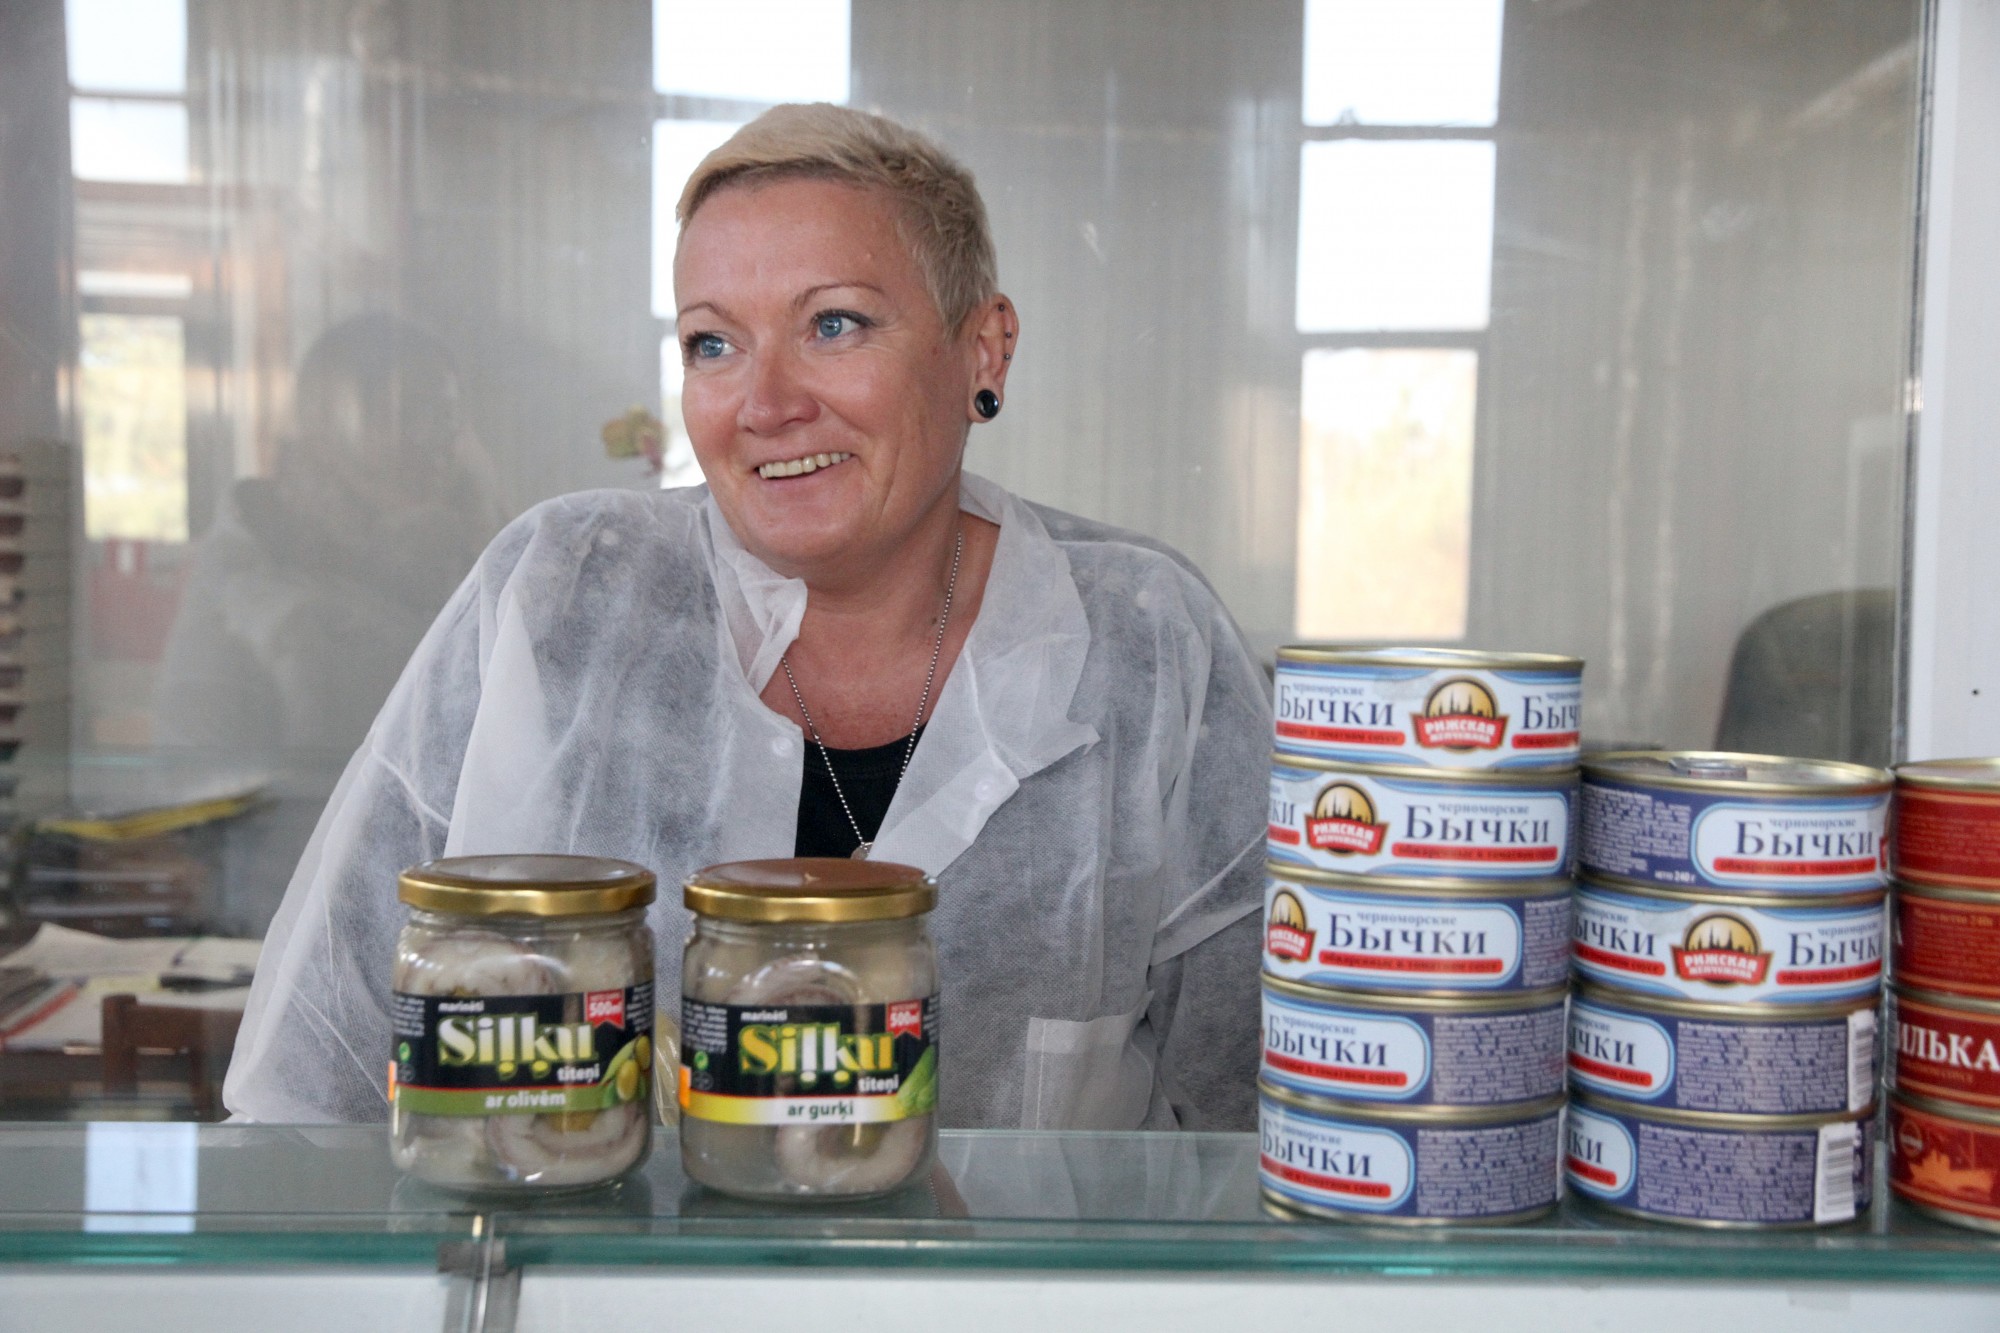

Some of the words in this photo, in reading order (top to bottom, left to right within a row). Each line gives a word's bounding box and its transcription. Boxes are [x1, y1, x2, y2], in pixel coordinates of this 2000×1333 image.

[1280, 684, 1394, 726] Бычки
[1522, 695, 1581, 731] Быч
[1405, 804, 1550, 844] Бычки
[1736, 820, 1874, 857] Бычки
[1328, 912, 1487, 954] Бычки
[1575, 915, 1657, 957] ычки
[1684, 953, 1758, 973] РИЖСКАЯ
[1268, 1014, 1388, 1066] Бычки
[485, 1095, 504, 1109] ar
[787, 1104, 805, 1117] ar
[808, 1099, 855, 1121] gurķi
[1262, 1118, 1371, 1177] Бычки
